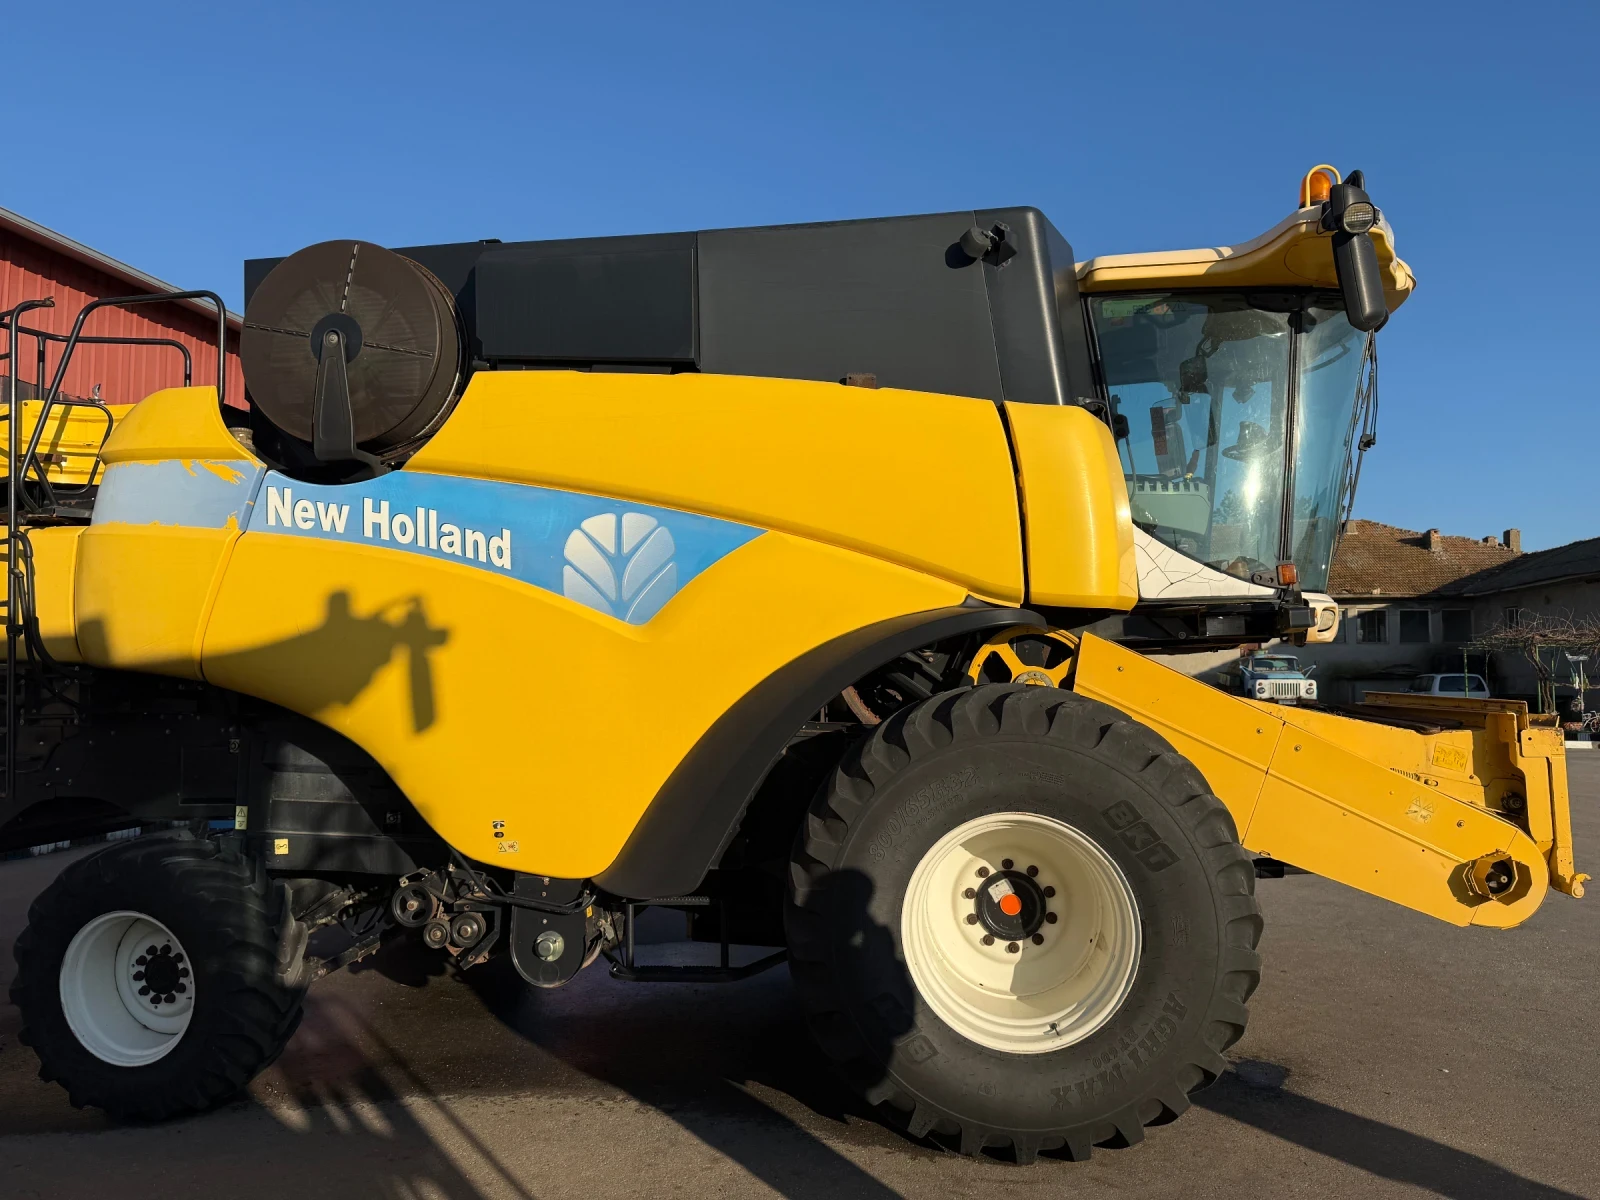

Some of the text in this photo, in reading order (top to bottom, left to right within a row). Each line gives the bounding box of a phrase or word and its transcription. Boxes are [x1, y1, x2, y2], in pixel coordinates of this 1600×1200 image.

[266, 486, 512, 570] New Holland
[1100, 800, 1181, 872] BKT
